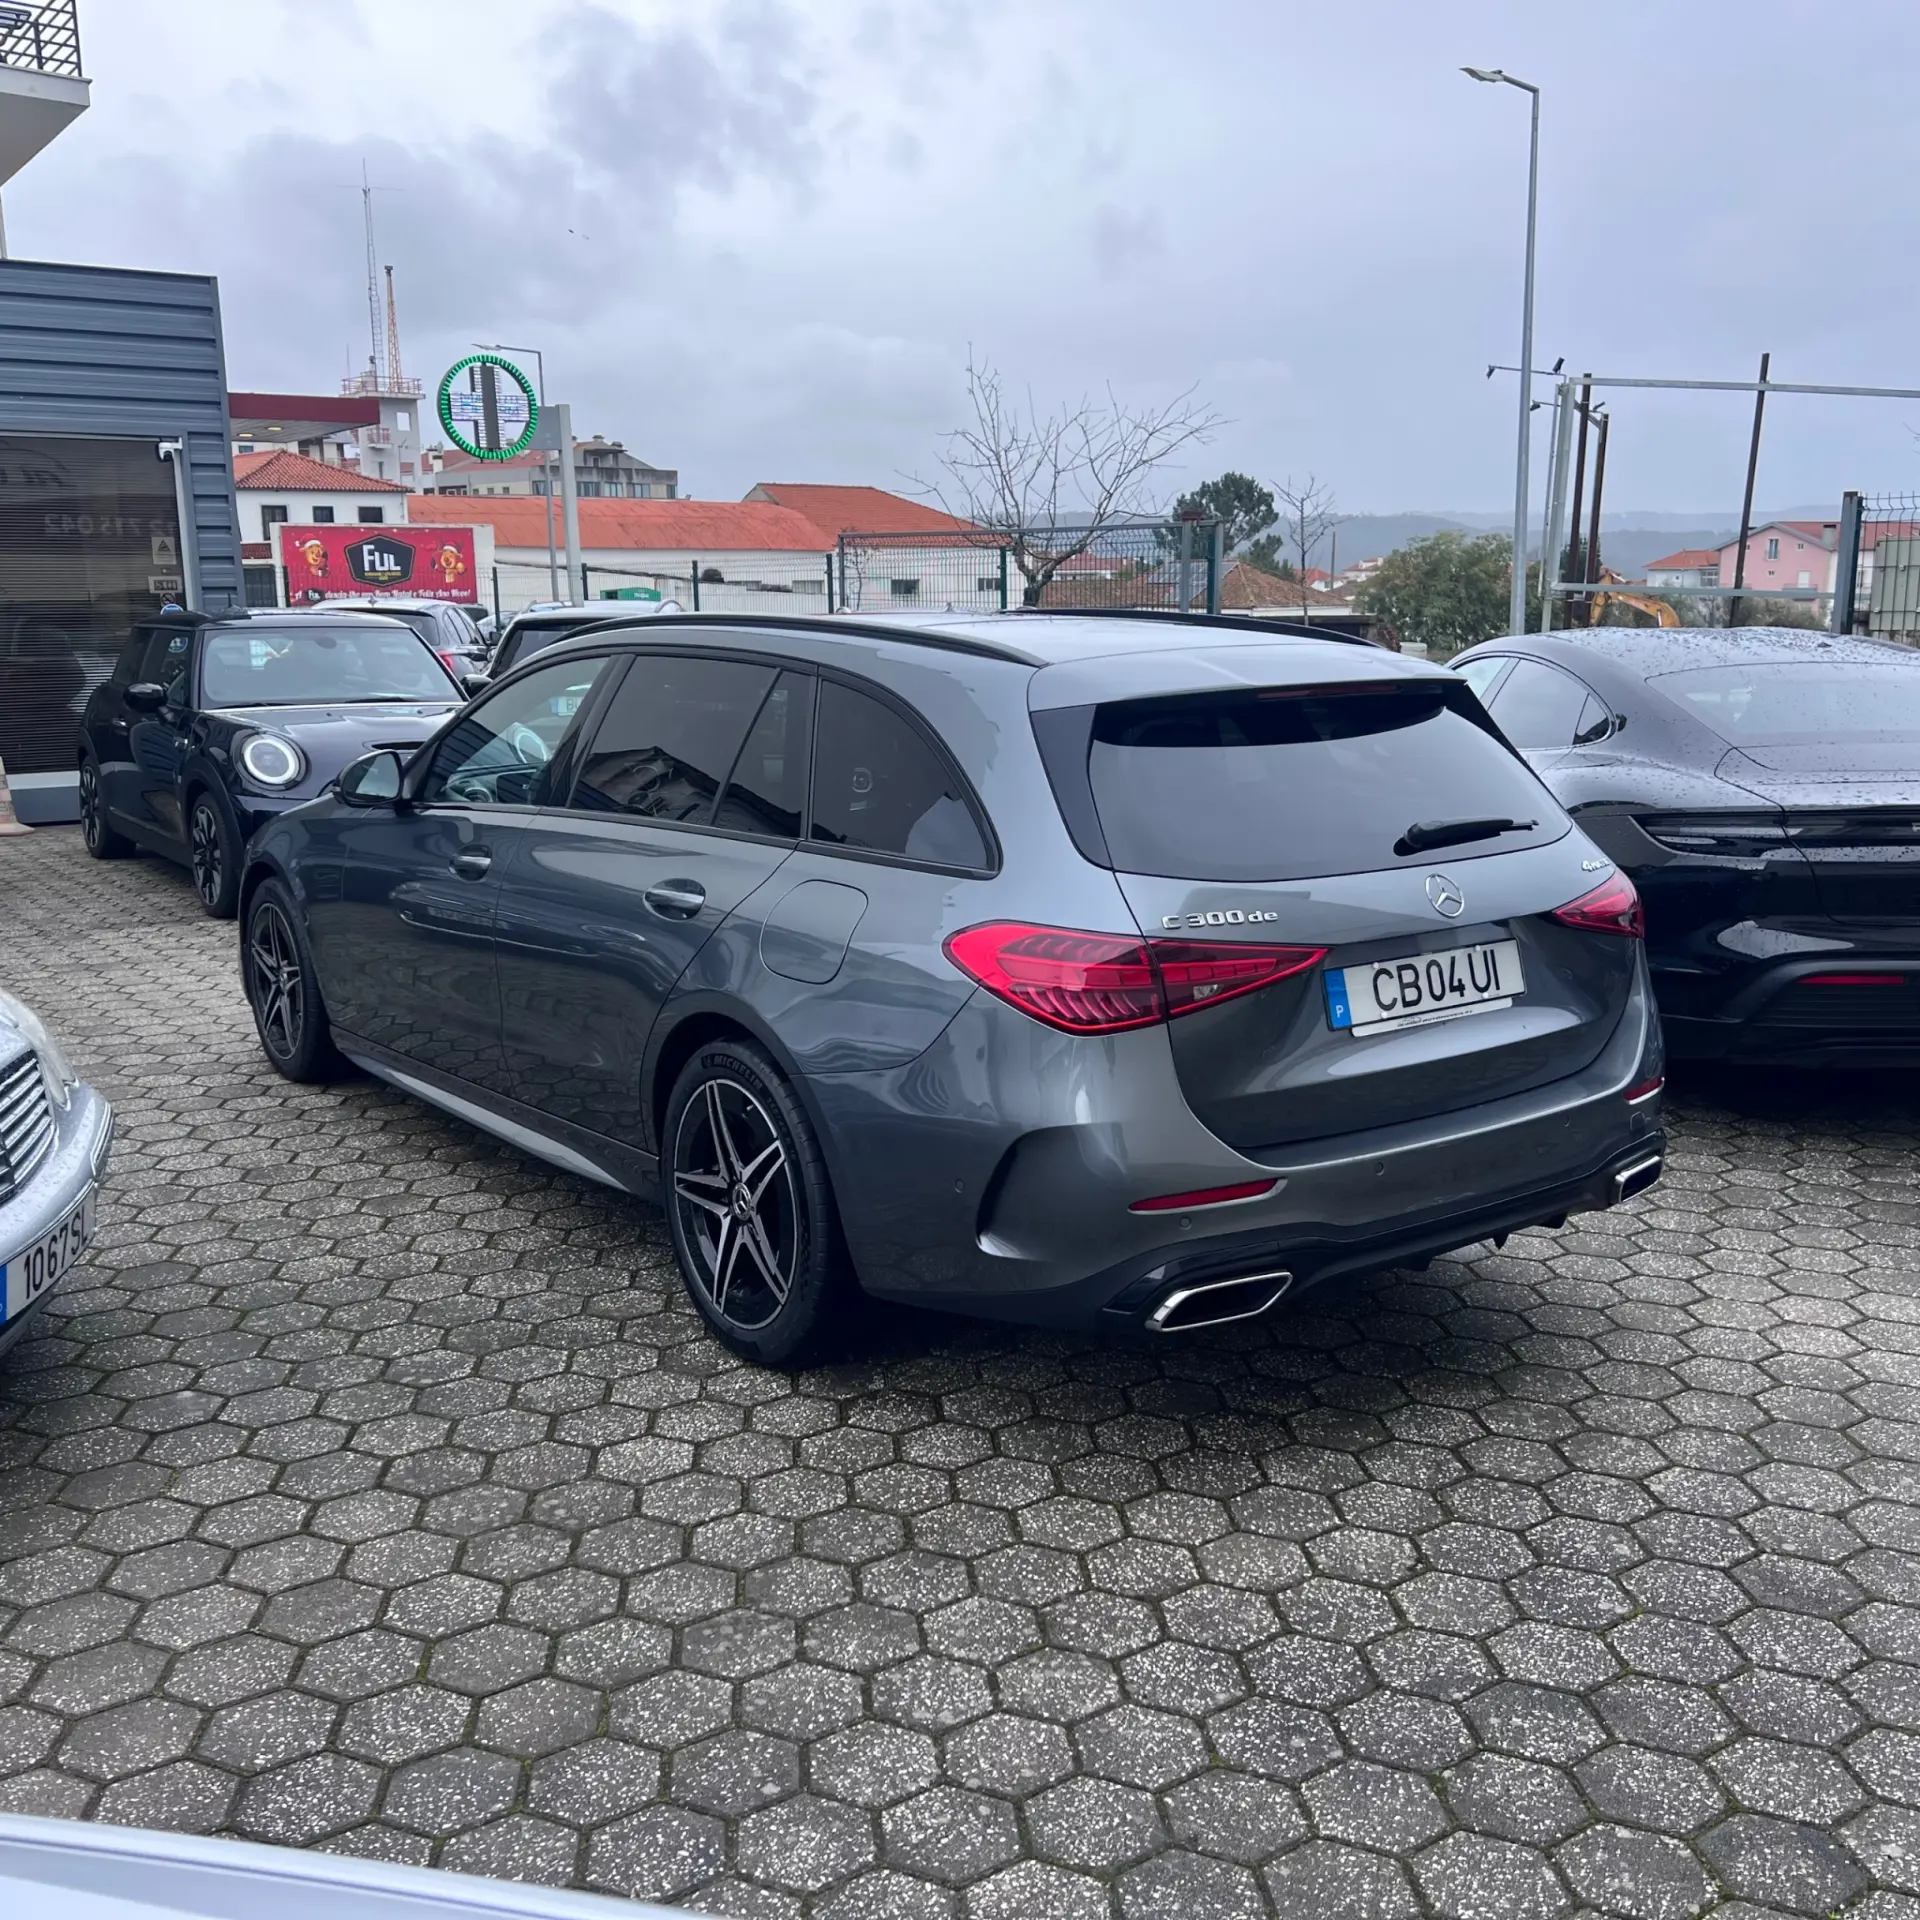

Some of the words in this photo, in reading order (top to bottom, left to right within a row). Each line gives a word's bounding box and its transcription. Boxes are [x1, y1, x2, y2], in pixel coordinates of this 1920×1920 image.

[392, 589, 412, 598] Natal
[418, 589, 434, 597] Feliz
[435, 589, 449, 598] Ano
[1162, 915, 1181, 929] C
[1186, 910, 1245, 928] 300
[1248, 910, 1279, 923] de
[1336, 1004, 1344, 1018] P
[714, 1055, 762, 1089] MICHELIN
[24, 1205, 87, 1299] 1067SL
